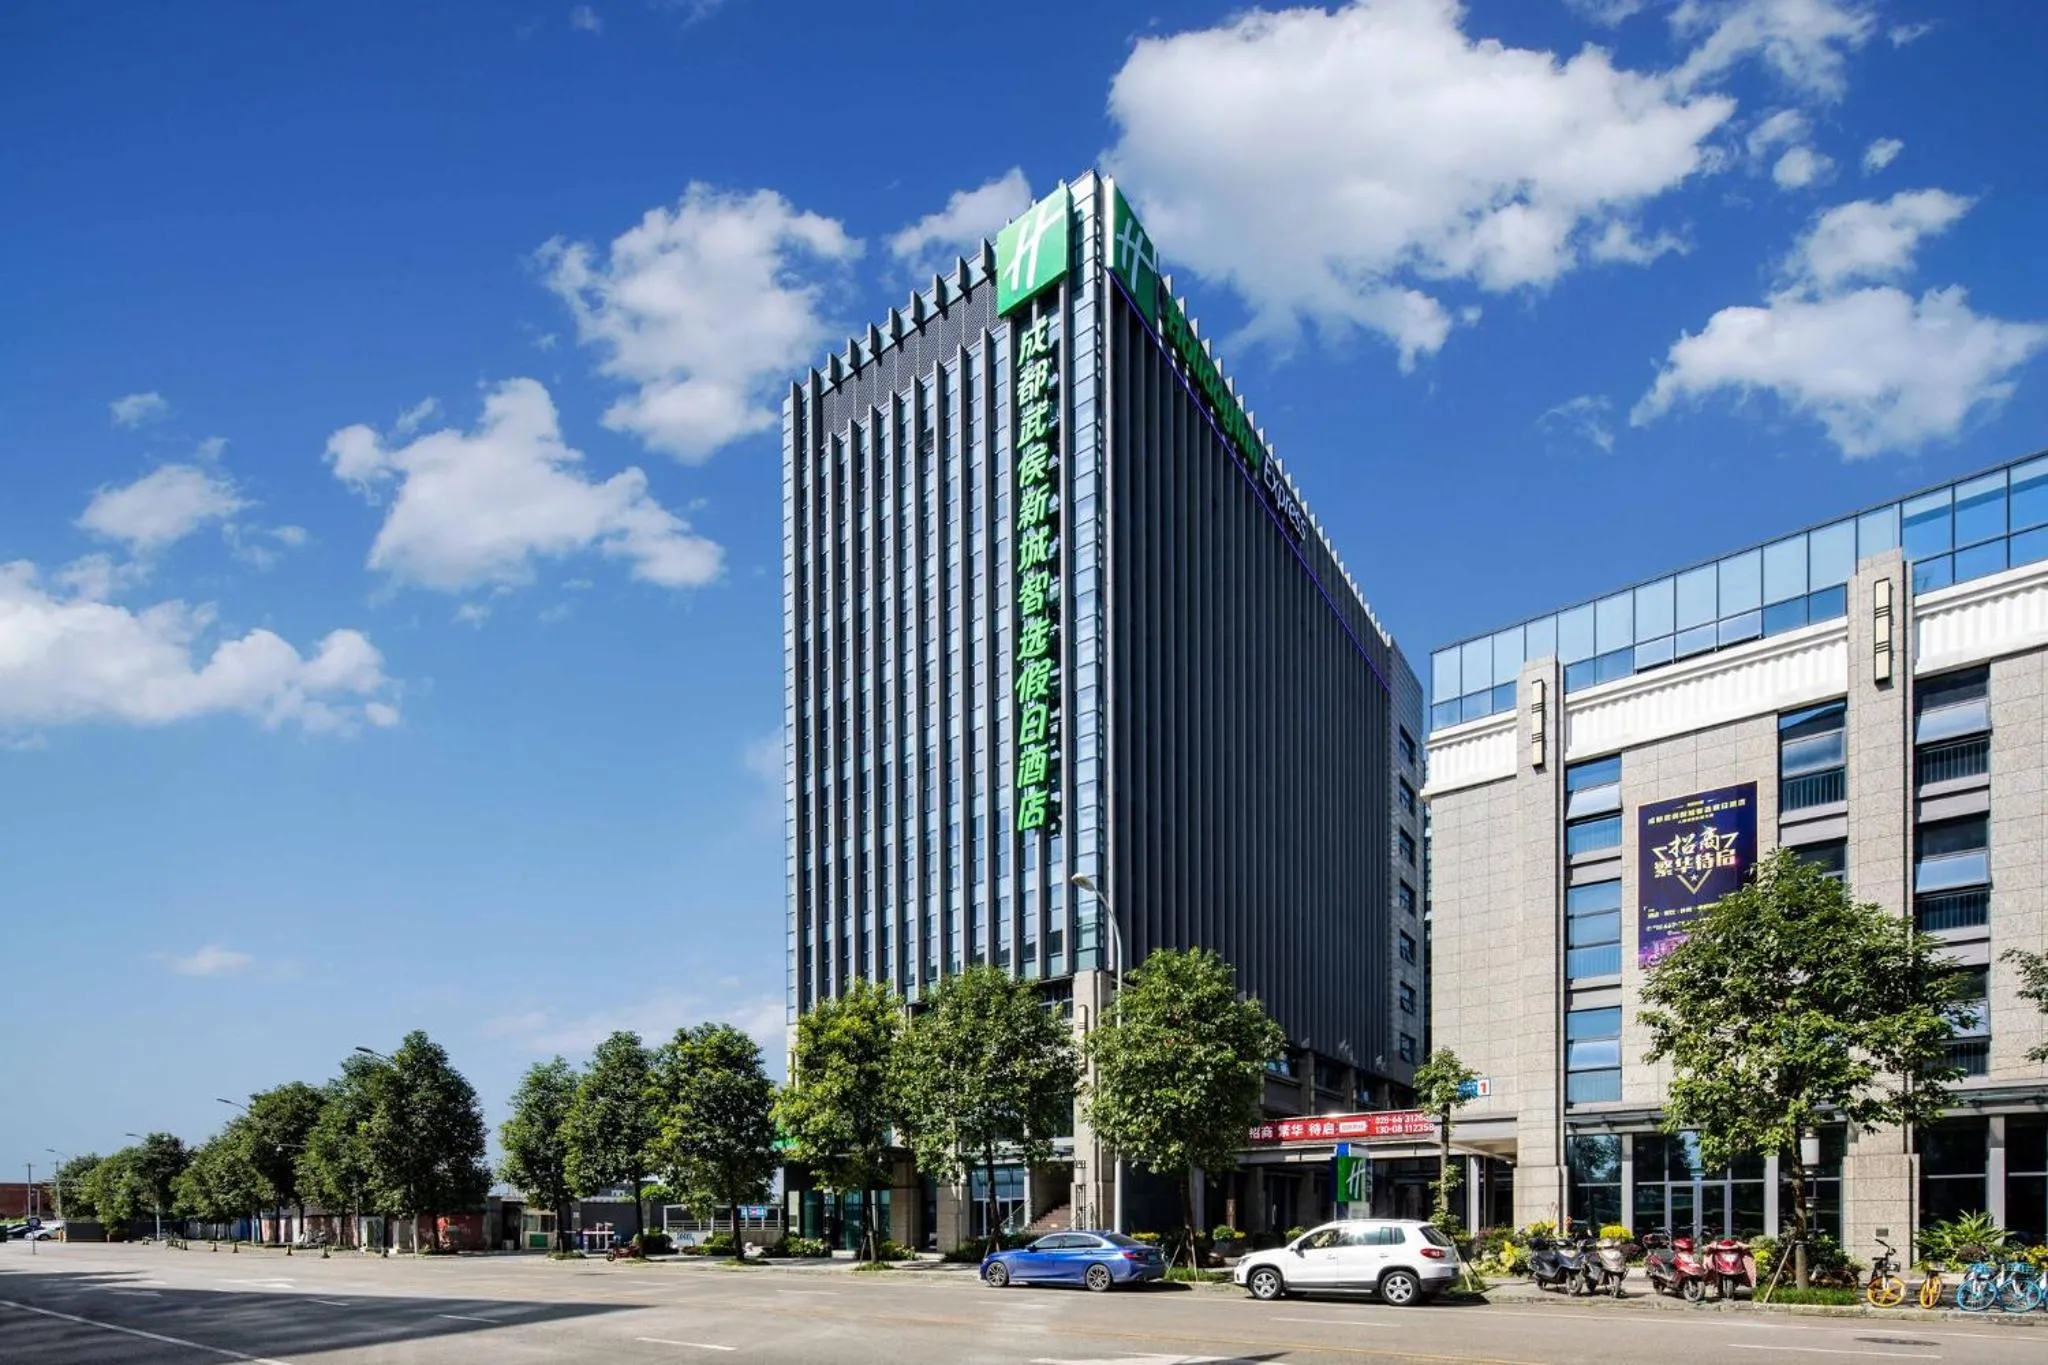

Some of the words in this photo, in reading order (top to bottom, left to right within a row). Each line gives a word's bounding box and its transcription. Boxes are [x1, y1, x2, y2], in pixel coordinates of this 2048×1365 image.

[1166, 297, 1234, 435] Holiday
[1264, 456, 1307, 540] Express
[1016, 315, 1052, 832] 成都武侯新城智选假日酒店
[1668, 826, 1720, 858] 招商
[1249, 1126, 1273, 1139] 招商
